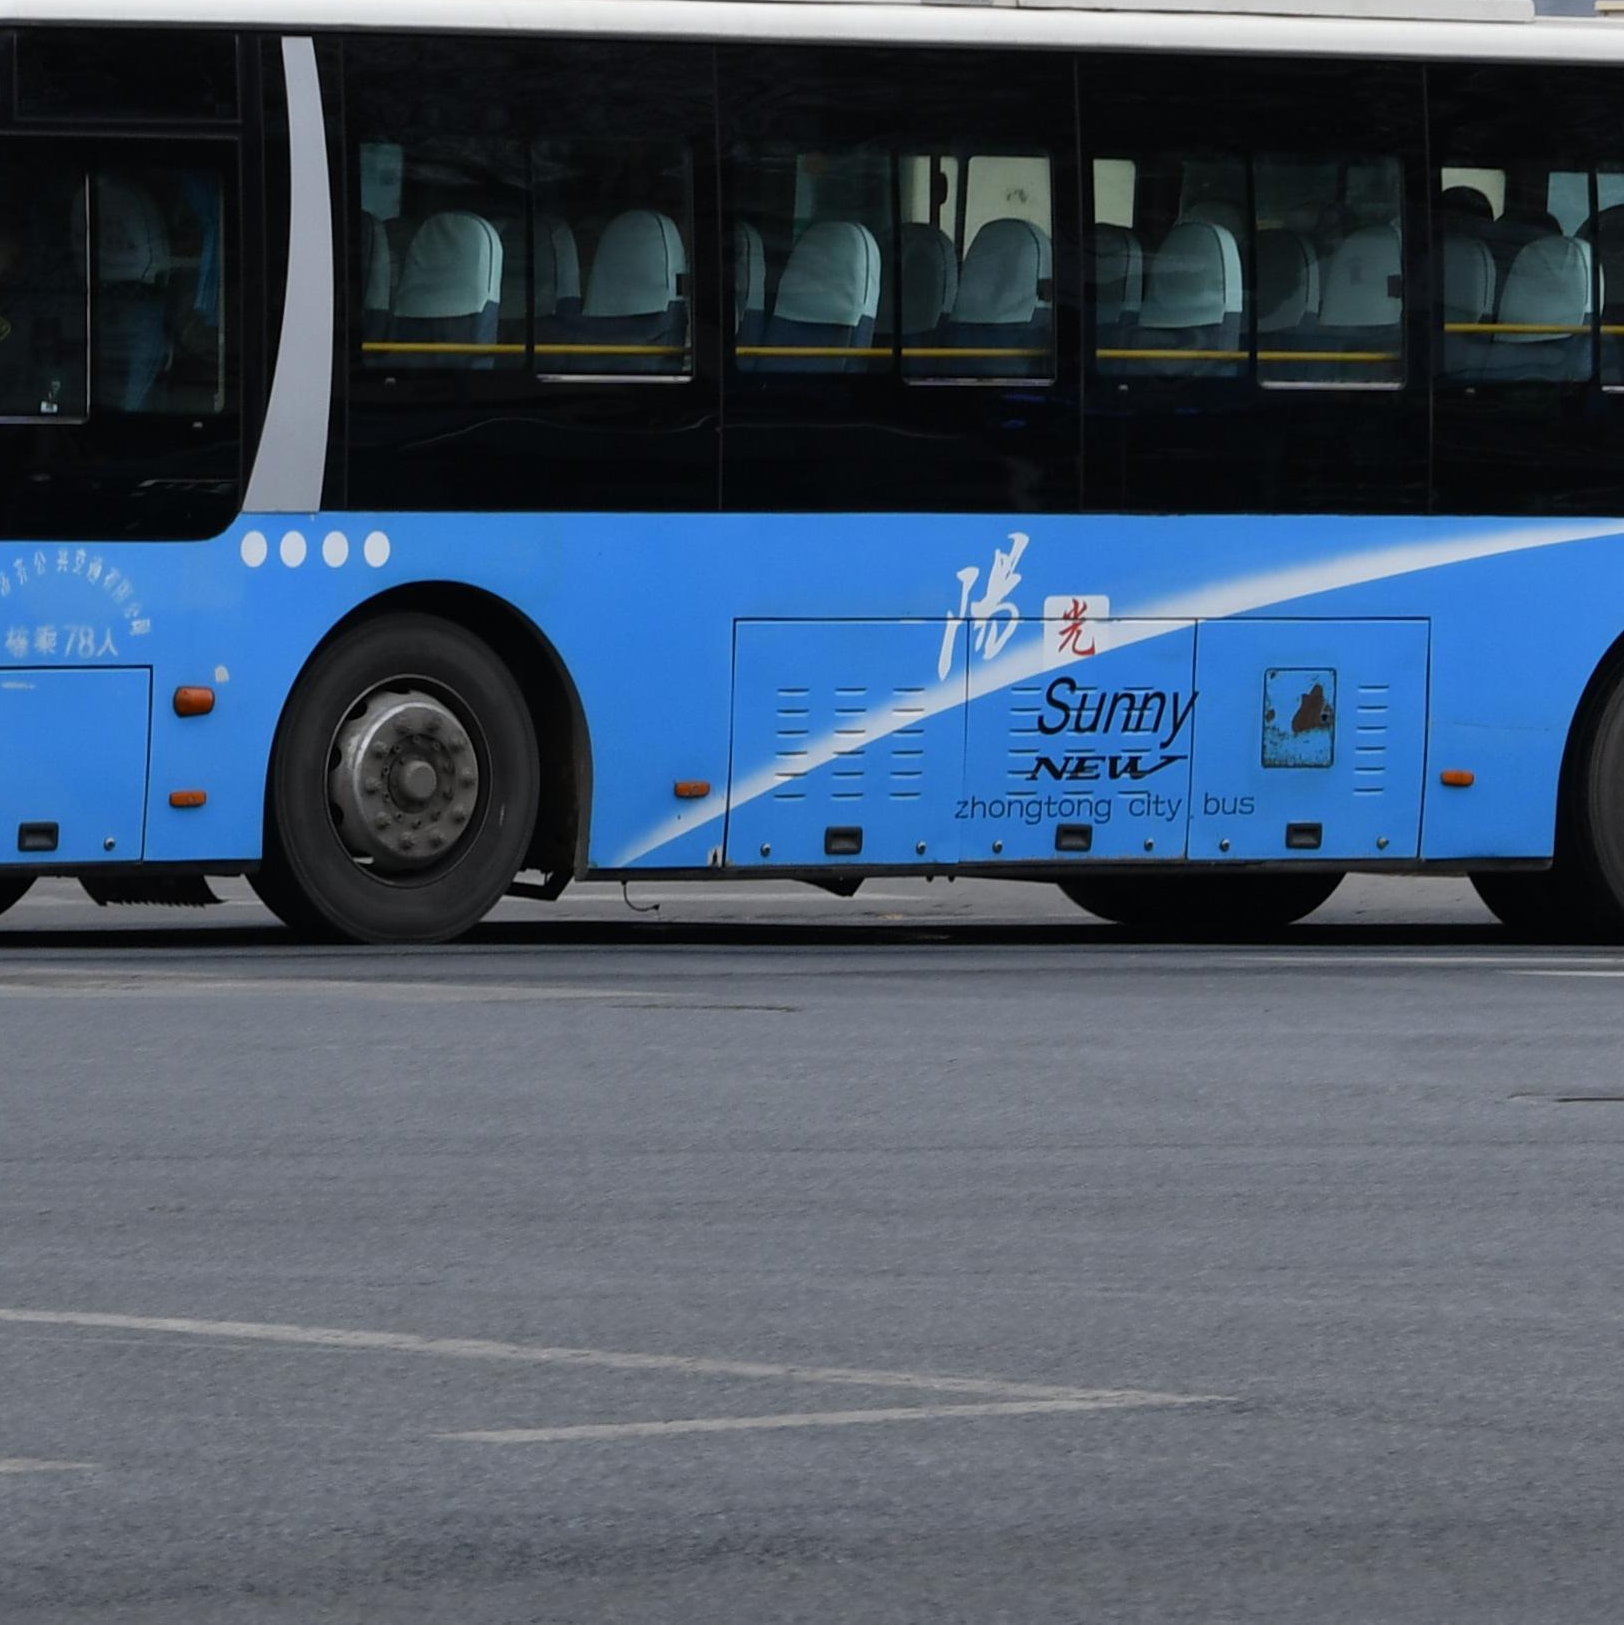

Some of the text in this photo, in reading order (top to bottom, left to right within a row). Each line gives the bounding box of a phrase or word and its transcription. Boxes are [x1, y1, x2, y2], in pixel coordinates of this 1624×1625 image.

[1037, 677, 1199, 749] Sunny
[1025, 755, 1189, 781] NEW
[954, 792, 1256, 824] zhongtong city bus
